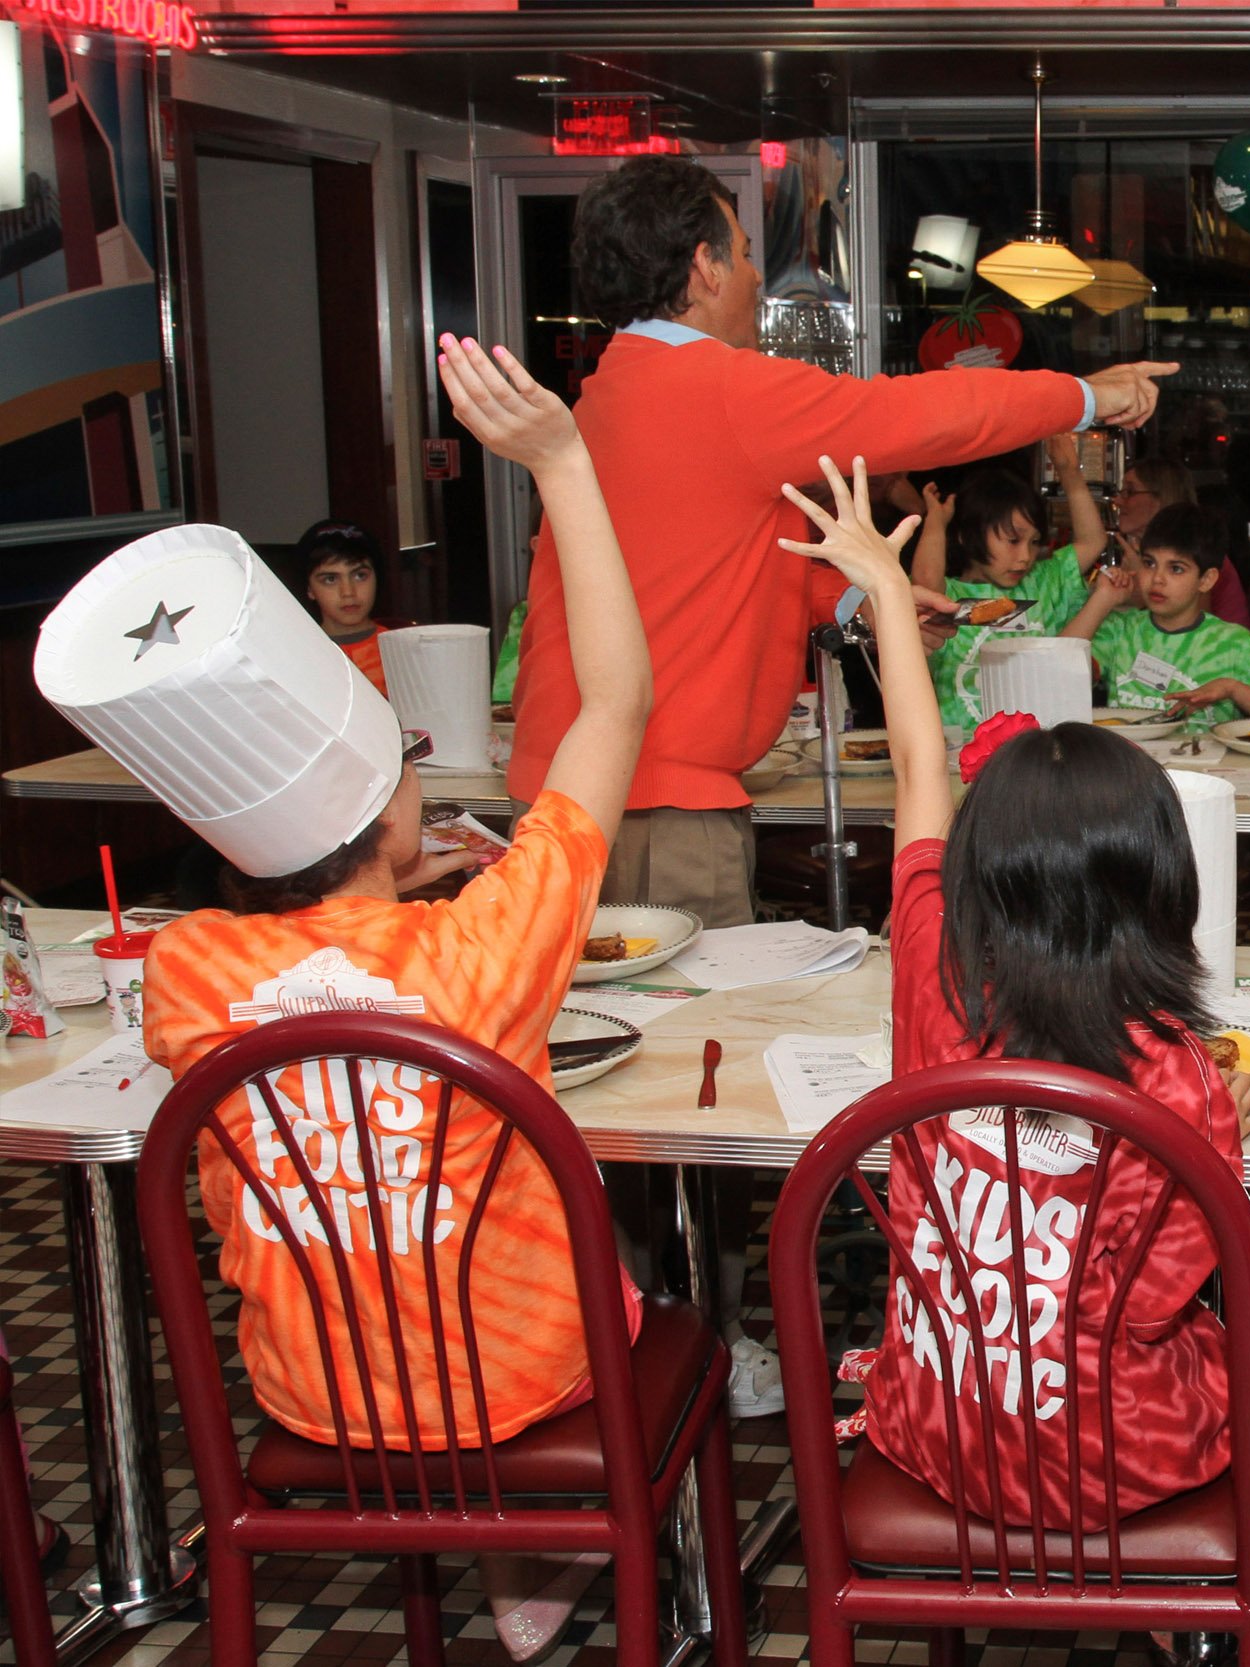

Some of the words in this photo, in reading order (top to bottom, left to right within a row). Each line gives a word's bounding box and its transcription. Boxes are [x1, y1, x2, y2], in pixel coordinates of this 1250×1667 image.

[251, 1118, 422, 1187] FOOD
[968, 1128, 998, 1146] LOCALLY
[1029, 1152, 1061, 1174] OPERATED
[242, 1178, 456, 1256] CRITIC
[911, 1217, 1060, 1346] FOOD
[896, 1275, 1066, 1421] CRITIC
